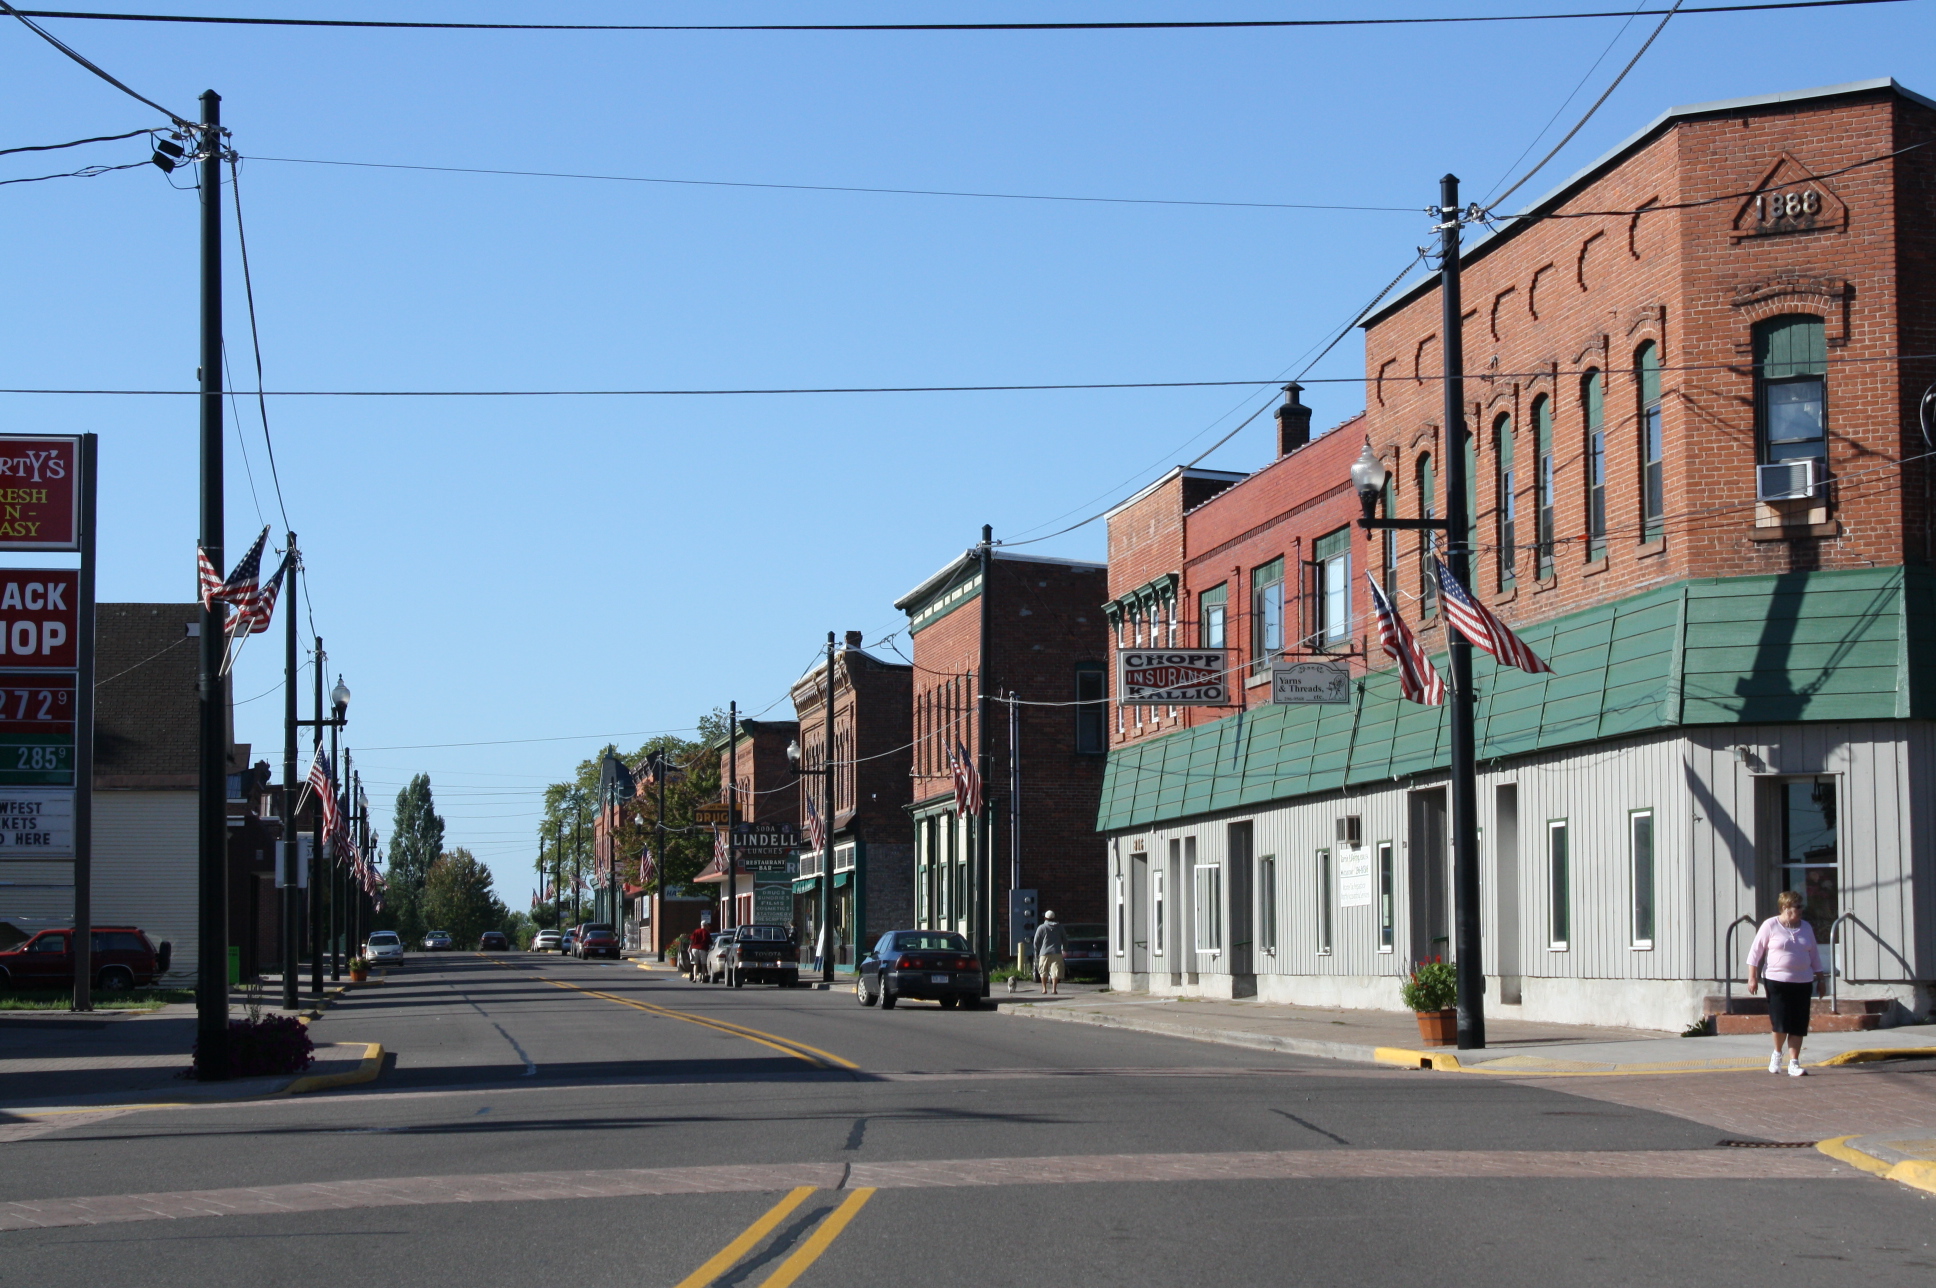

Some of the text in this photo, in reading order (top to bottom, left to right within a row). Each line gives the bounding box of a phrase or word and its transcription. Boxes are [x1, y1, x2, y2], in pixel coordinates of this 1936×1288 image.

[1756, 189, 1818, 220] 1888
[0, 450, 65, 482] RTY'S
[0, 521, 41, 536] ASY
[1, 582, 67, 610] ACK
[0, 620, 67, 655] OP
[1125, 655, 1220, 668] CHOPP
[1127, 668, 1220, 687] INSURANCE
[1279, 677, 1302, 685] Yarns
[1128, 687, 1222, 699] KALLIO
[1278, 685, 1324, 693] & Threads,
[2, 817, 37, 829] KETS
[16, 833, 50, 845] HERE
[733, 834, 798, 846] LINDELL
